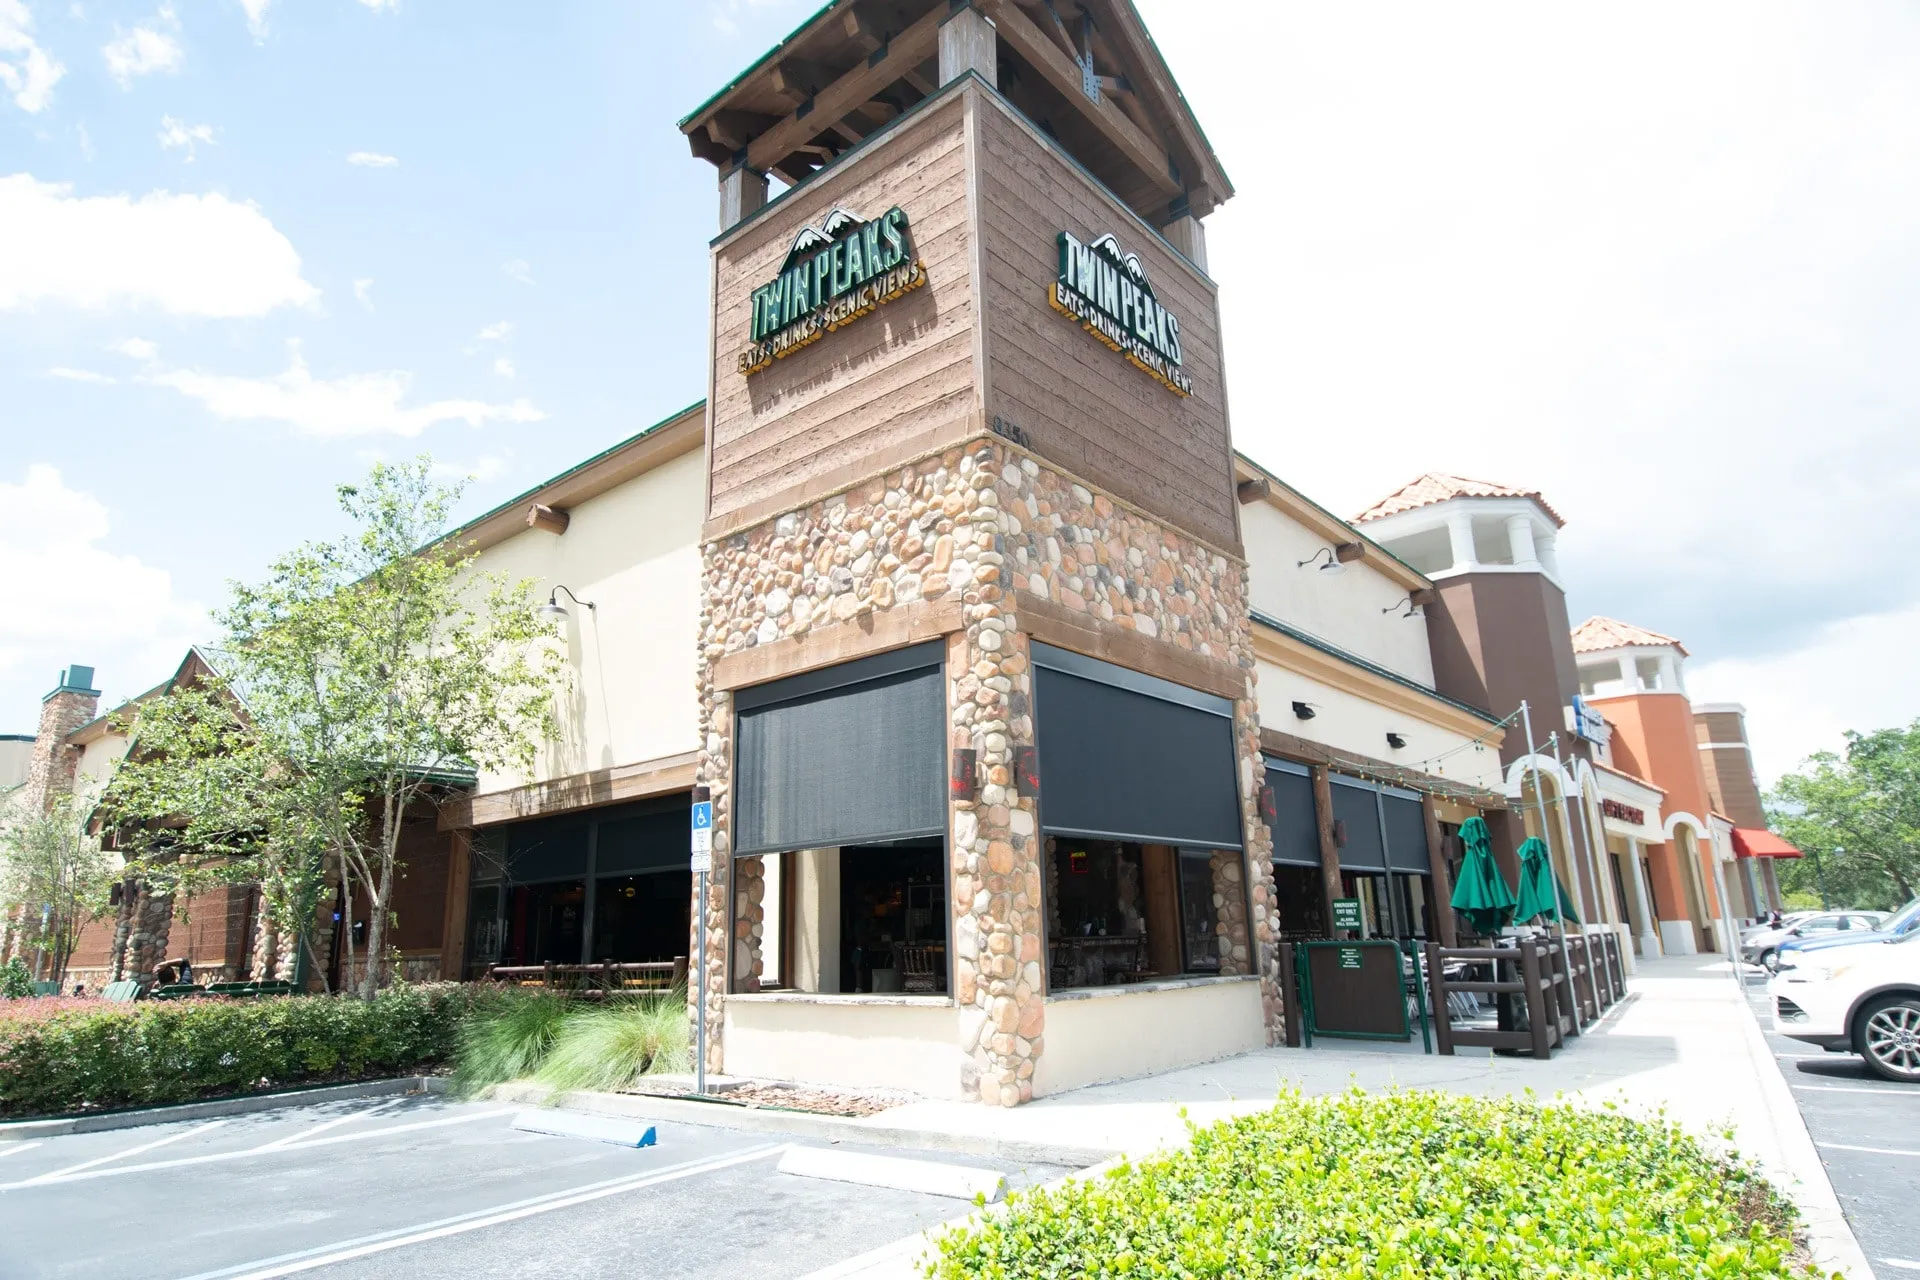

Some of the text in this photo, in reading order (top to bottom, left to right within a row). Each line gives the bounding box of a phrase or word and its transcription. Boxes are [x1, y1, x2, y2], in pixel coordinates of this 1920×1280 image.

[738, 259, 926, 375] EATS DRINKS SCENIC VIEWS
[750, 206, 910, 343] TWIN PEAKS
[1054, 283, 1084, 318] EATS
[1088, 308, 1127, 349] DRINKS
[1131, 339, 1164, 376] SCENIC
[1060, 231, 1182, 366] TWIN PEAKS
